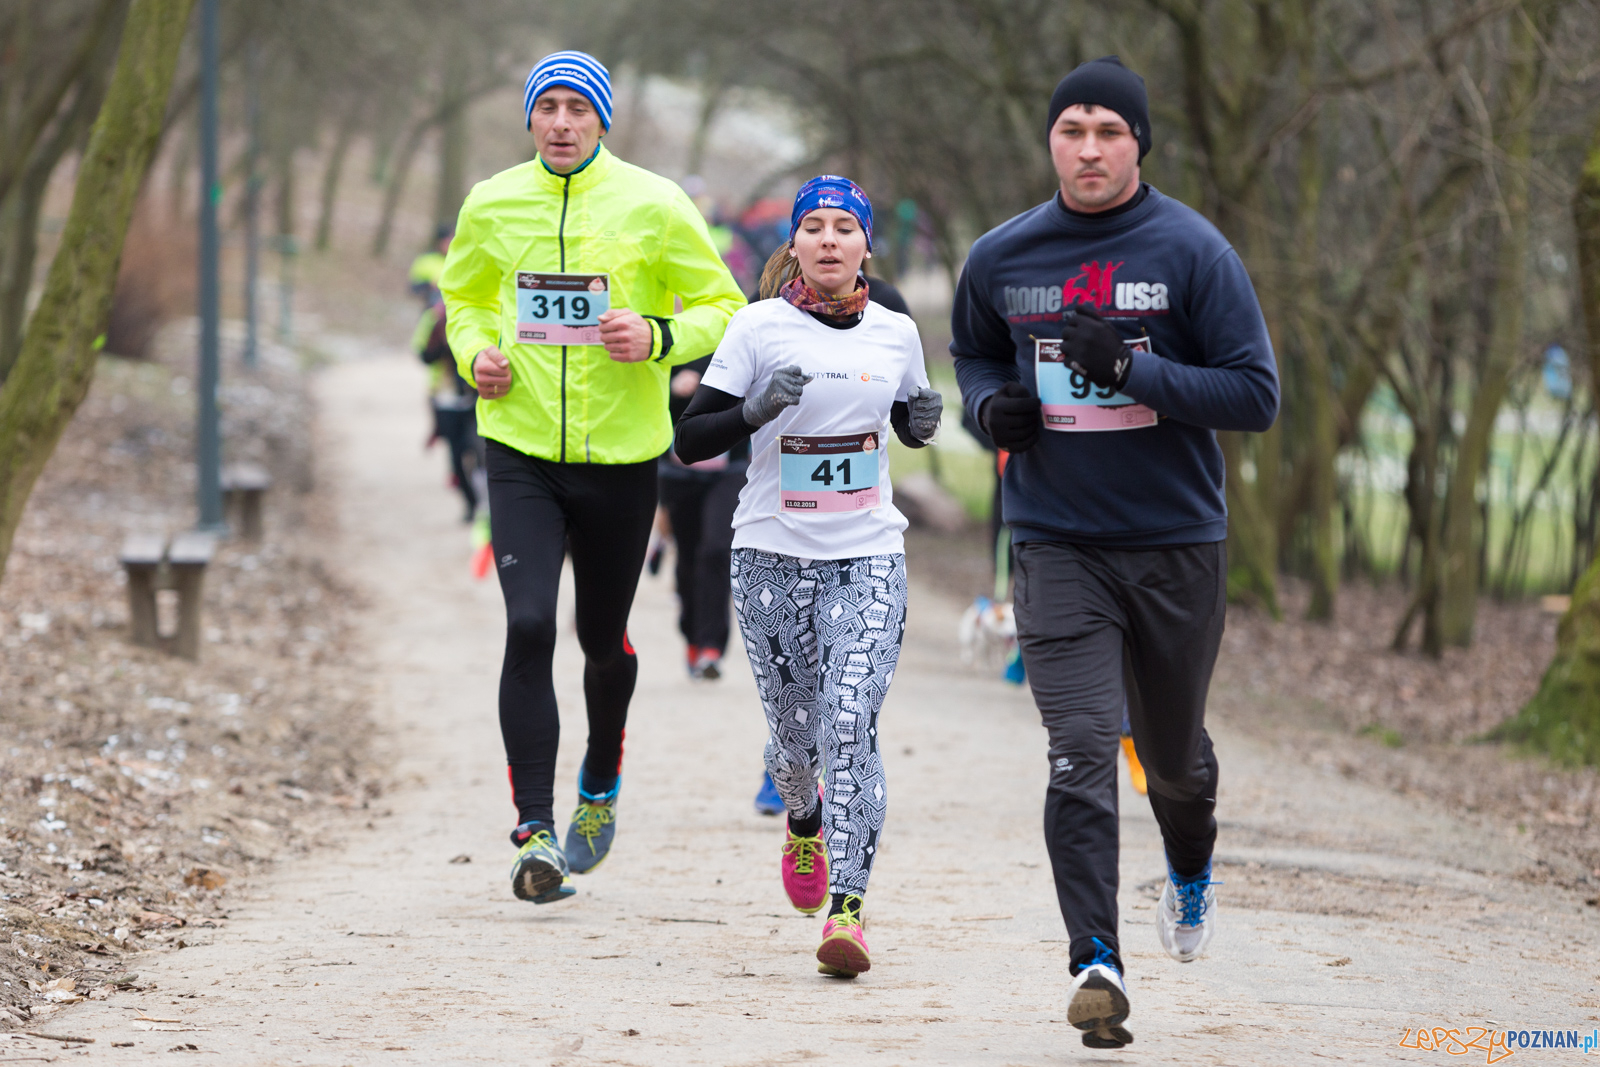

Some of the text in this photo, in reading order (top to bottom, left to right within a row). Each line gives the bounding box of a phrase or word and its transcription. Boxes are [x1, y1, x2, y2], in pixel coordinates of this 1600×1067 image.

[532, 295, 590, 320] 319
[1004, 285, 1062, 315] bone
[1115, 282, 1170, 310] usa
[811, 458, 851, 486] 41
